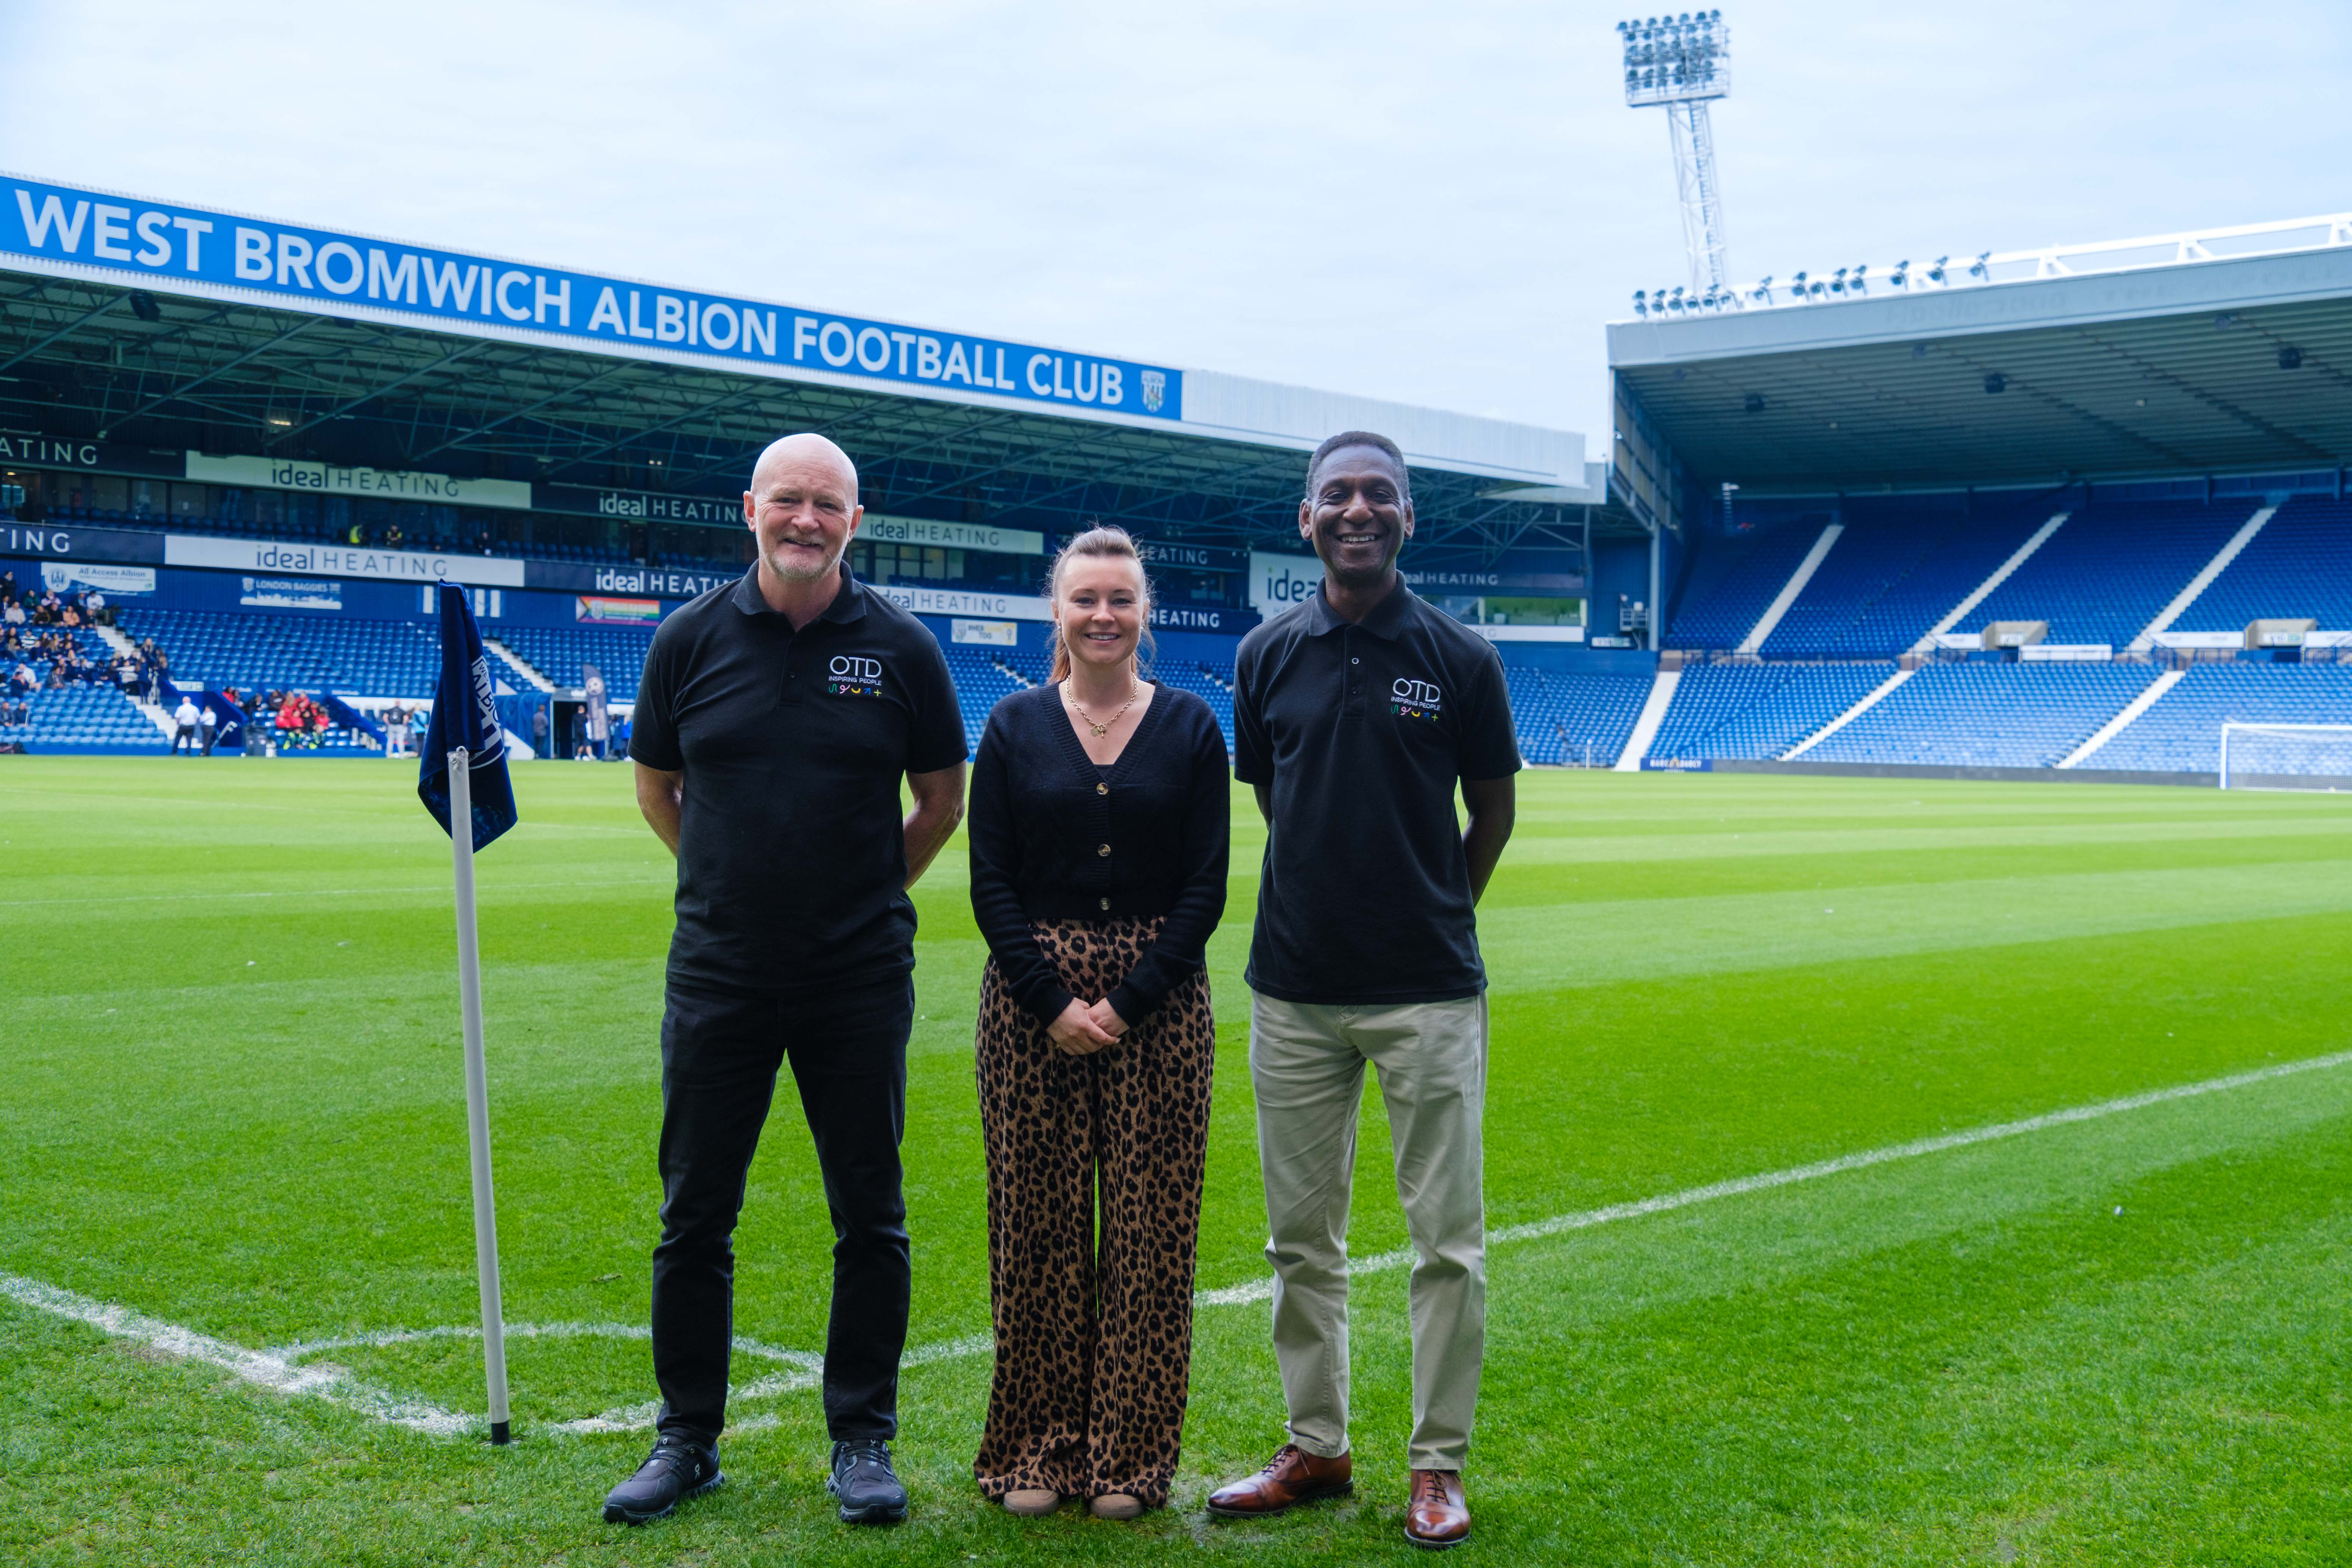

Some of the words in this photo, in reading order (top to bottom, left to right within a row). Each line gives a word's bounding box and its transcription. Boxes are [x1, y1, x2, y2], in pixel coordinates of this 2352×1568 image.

[14, 189, 214, 272] WEST
[235, 226, 571, 327] BROMWICH
[587, 286, 776, 356] ALBION
[794, 316, 1015, 390] FOOTBALL
[1026, 354, 1124, 405] CLUB
[272, 460, 328, 488] ideal
[337, 471, 459, 497] HEATING
[599, 490, 647, 516] ideal
[0, 528, 70, 553] ING
[871, 519, 909, 539] ideal
[915, 524, 1000, 546] HEATING
[256, 545, 314, 570] ideal
[323, 551, 447, 577] HEATING
[256, 580, 293, 590] LONDON
[293, 582, 328, 592] BAGGIES
[596, 568, 645, 593] ideal
[1427, 572, 1498, 585] HEATING
[921, 593, 1006, 613] HEATING
[1147, 608, 1220, 628] HEATING
[830, 656, 882, 678] OTD
[859, 677, 882, 686] PEOPLE
[1393, 678, 1441, 702] OTD
[1391, 696, 1418, 706] INSPIRING
[1419, 702, 1441, 711] PEOPLE
